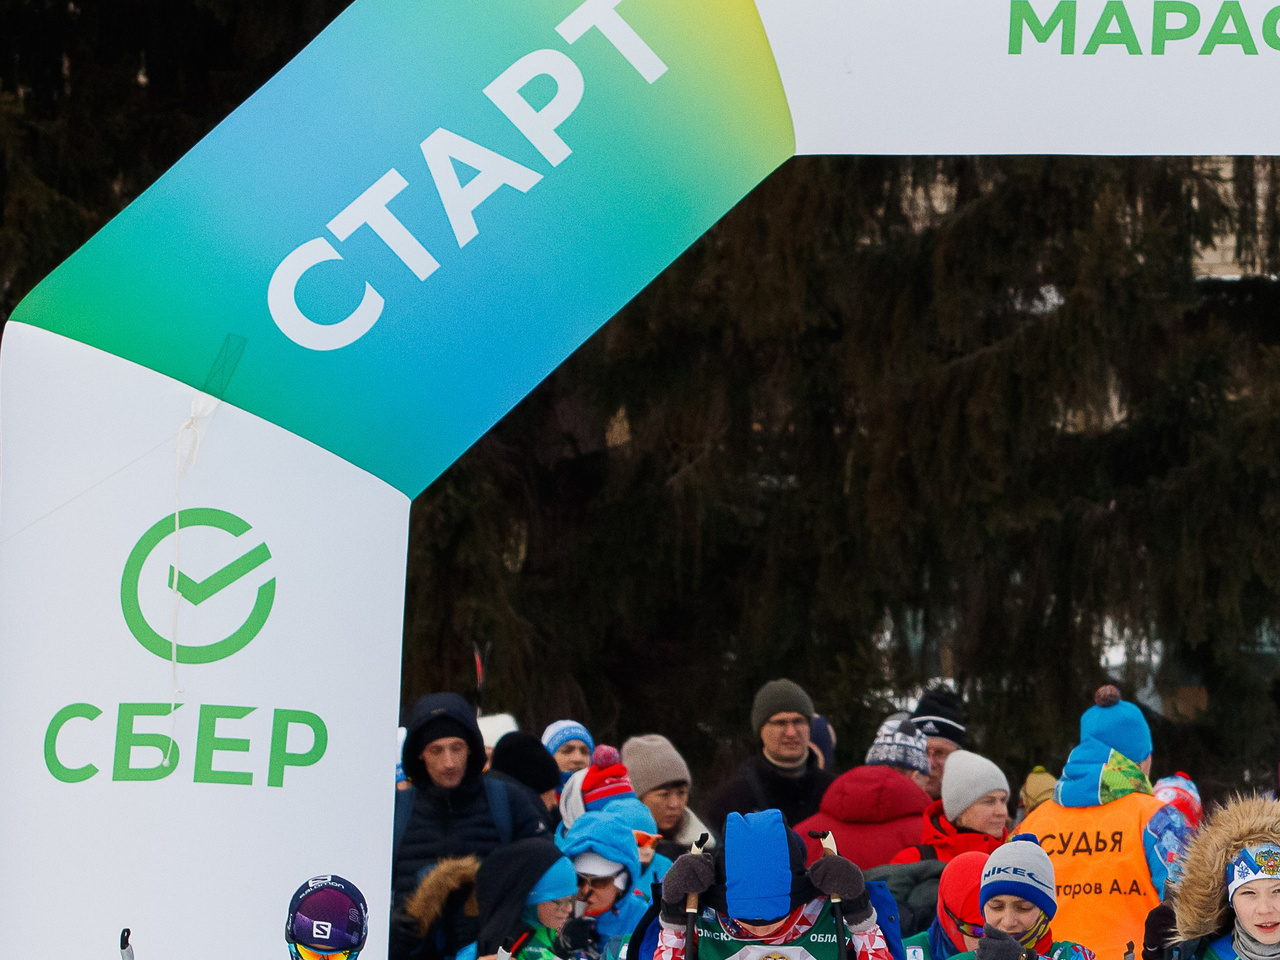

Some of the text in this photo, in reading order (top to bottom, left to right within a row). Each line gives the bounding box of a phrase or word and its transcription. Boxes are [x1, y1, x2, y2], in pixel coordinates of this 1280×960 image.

[267, 0, 668, 351] СТАРТ
[43, 702, 329, 788] СБЕР
[1040, 831, 1123, 856] СУДЬЯ
[983, 866, 1026, 881] NIKE
[1056, 878, 1148, 899] таров А.А.
